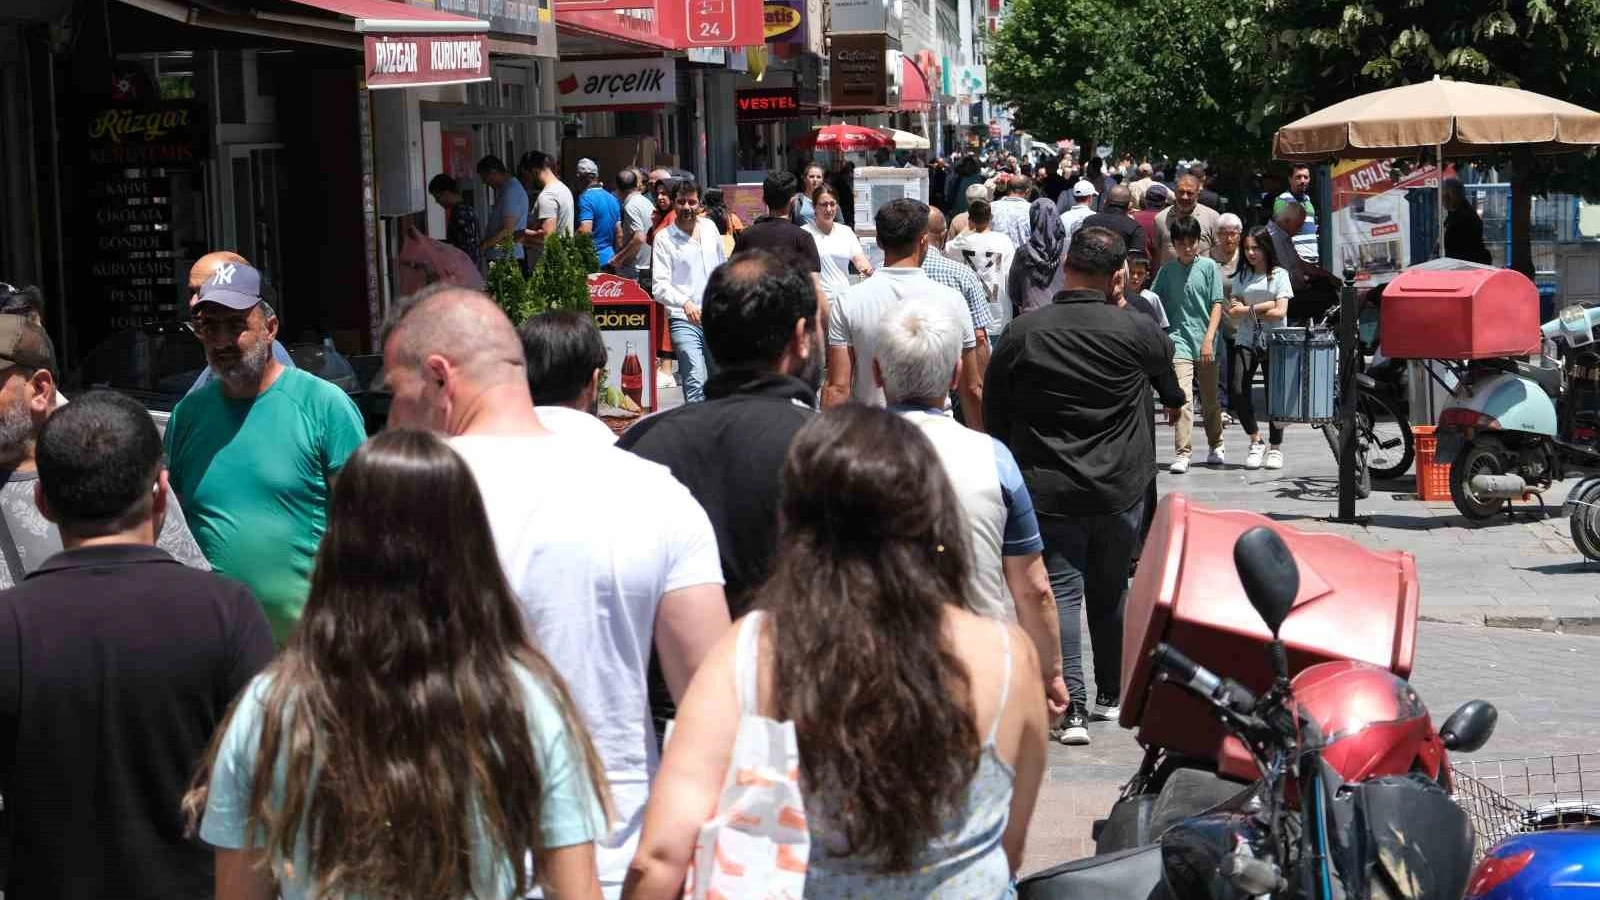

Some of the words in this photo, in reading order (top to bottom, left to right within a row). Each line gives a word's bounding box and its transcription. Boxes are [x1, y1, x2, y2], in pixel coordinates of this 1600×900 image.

[700, 22, 721, 37] 24
[374, 36, 418, 73] RÜZGAR
[430, 35, 481, 73] KURUYEMİŞ
[584, 69, 665, 98] arçelik
[739, 96, 797, 110] VESTEL
[88, 108, 189, 142] Rüzgar
[212, 262, 237, 285] NY
[594, 310, 647, 327] döner
